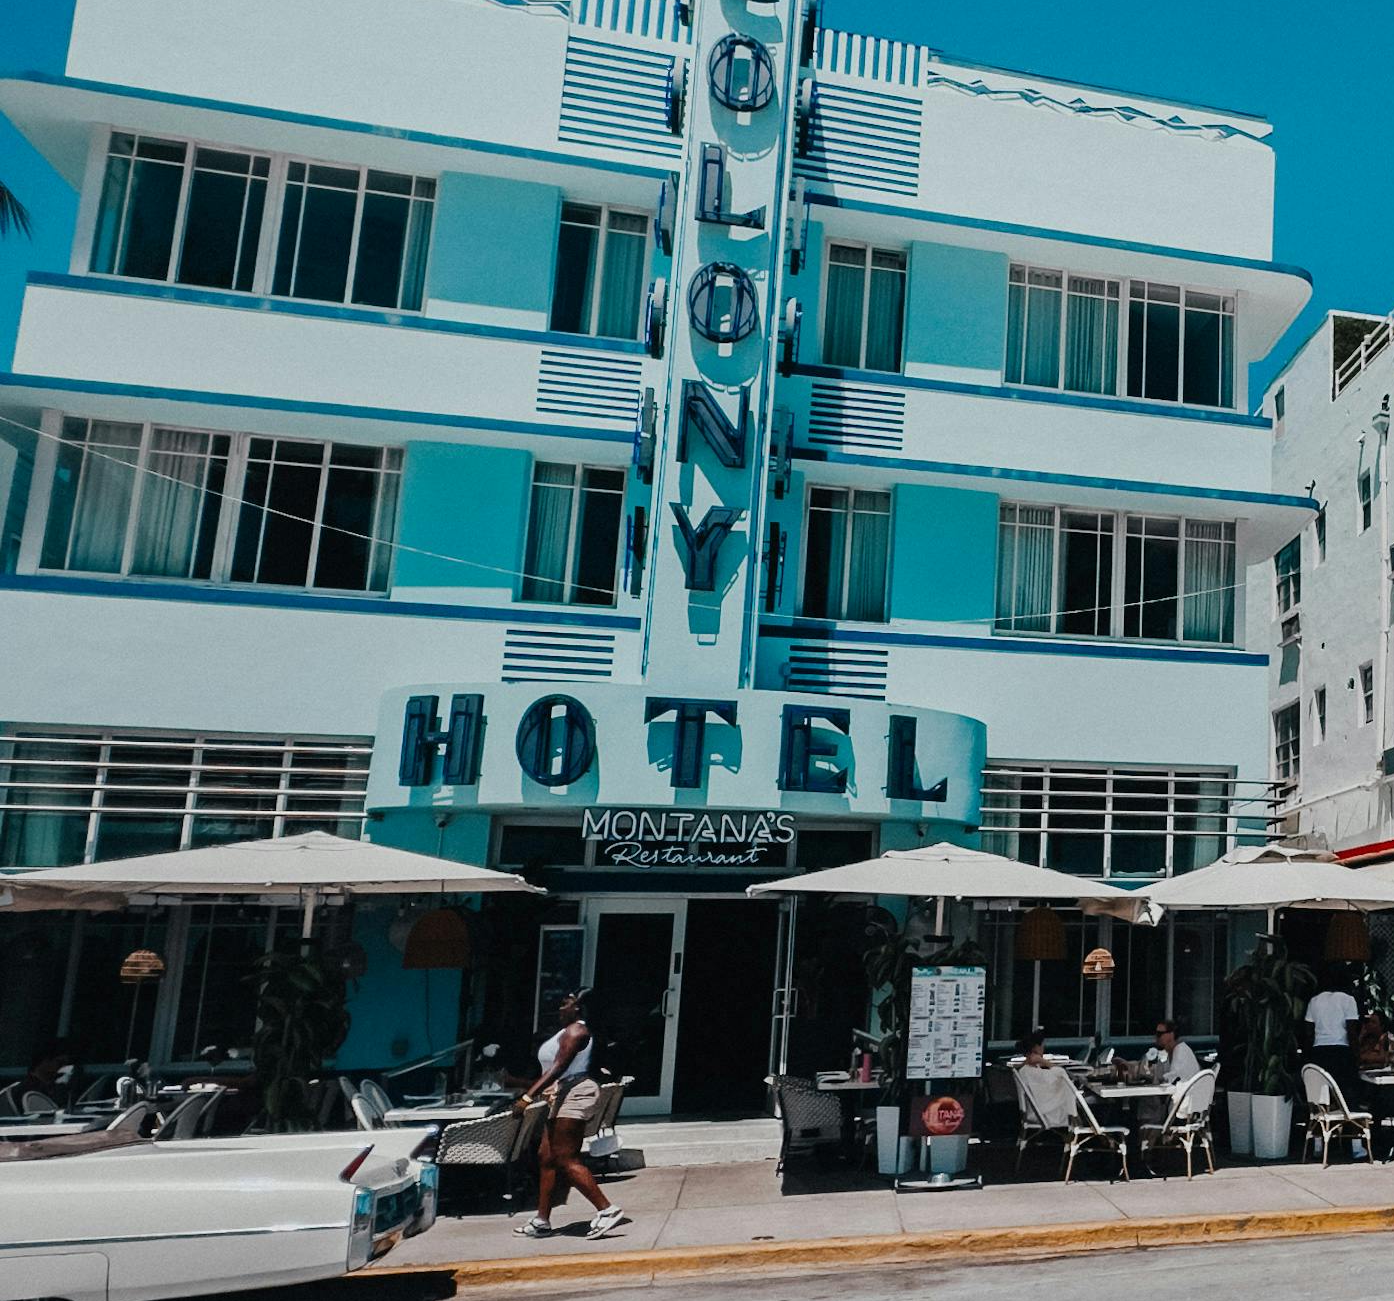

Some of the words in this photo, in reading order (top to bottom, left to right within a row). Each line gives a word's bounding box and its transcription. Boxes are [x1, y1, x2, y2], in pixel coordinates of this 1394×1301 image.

[399, 693, 948, 803] HOTEL
[581, 808, 795, 844] MONTANA'S
[604, 841, 768, 869] Restaurant
